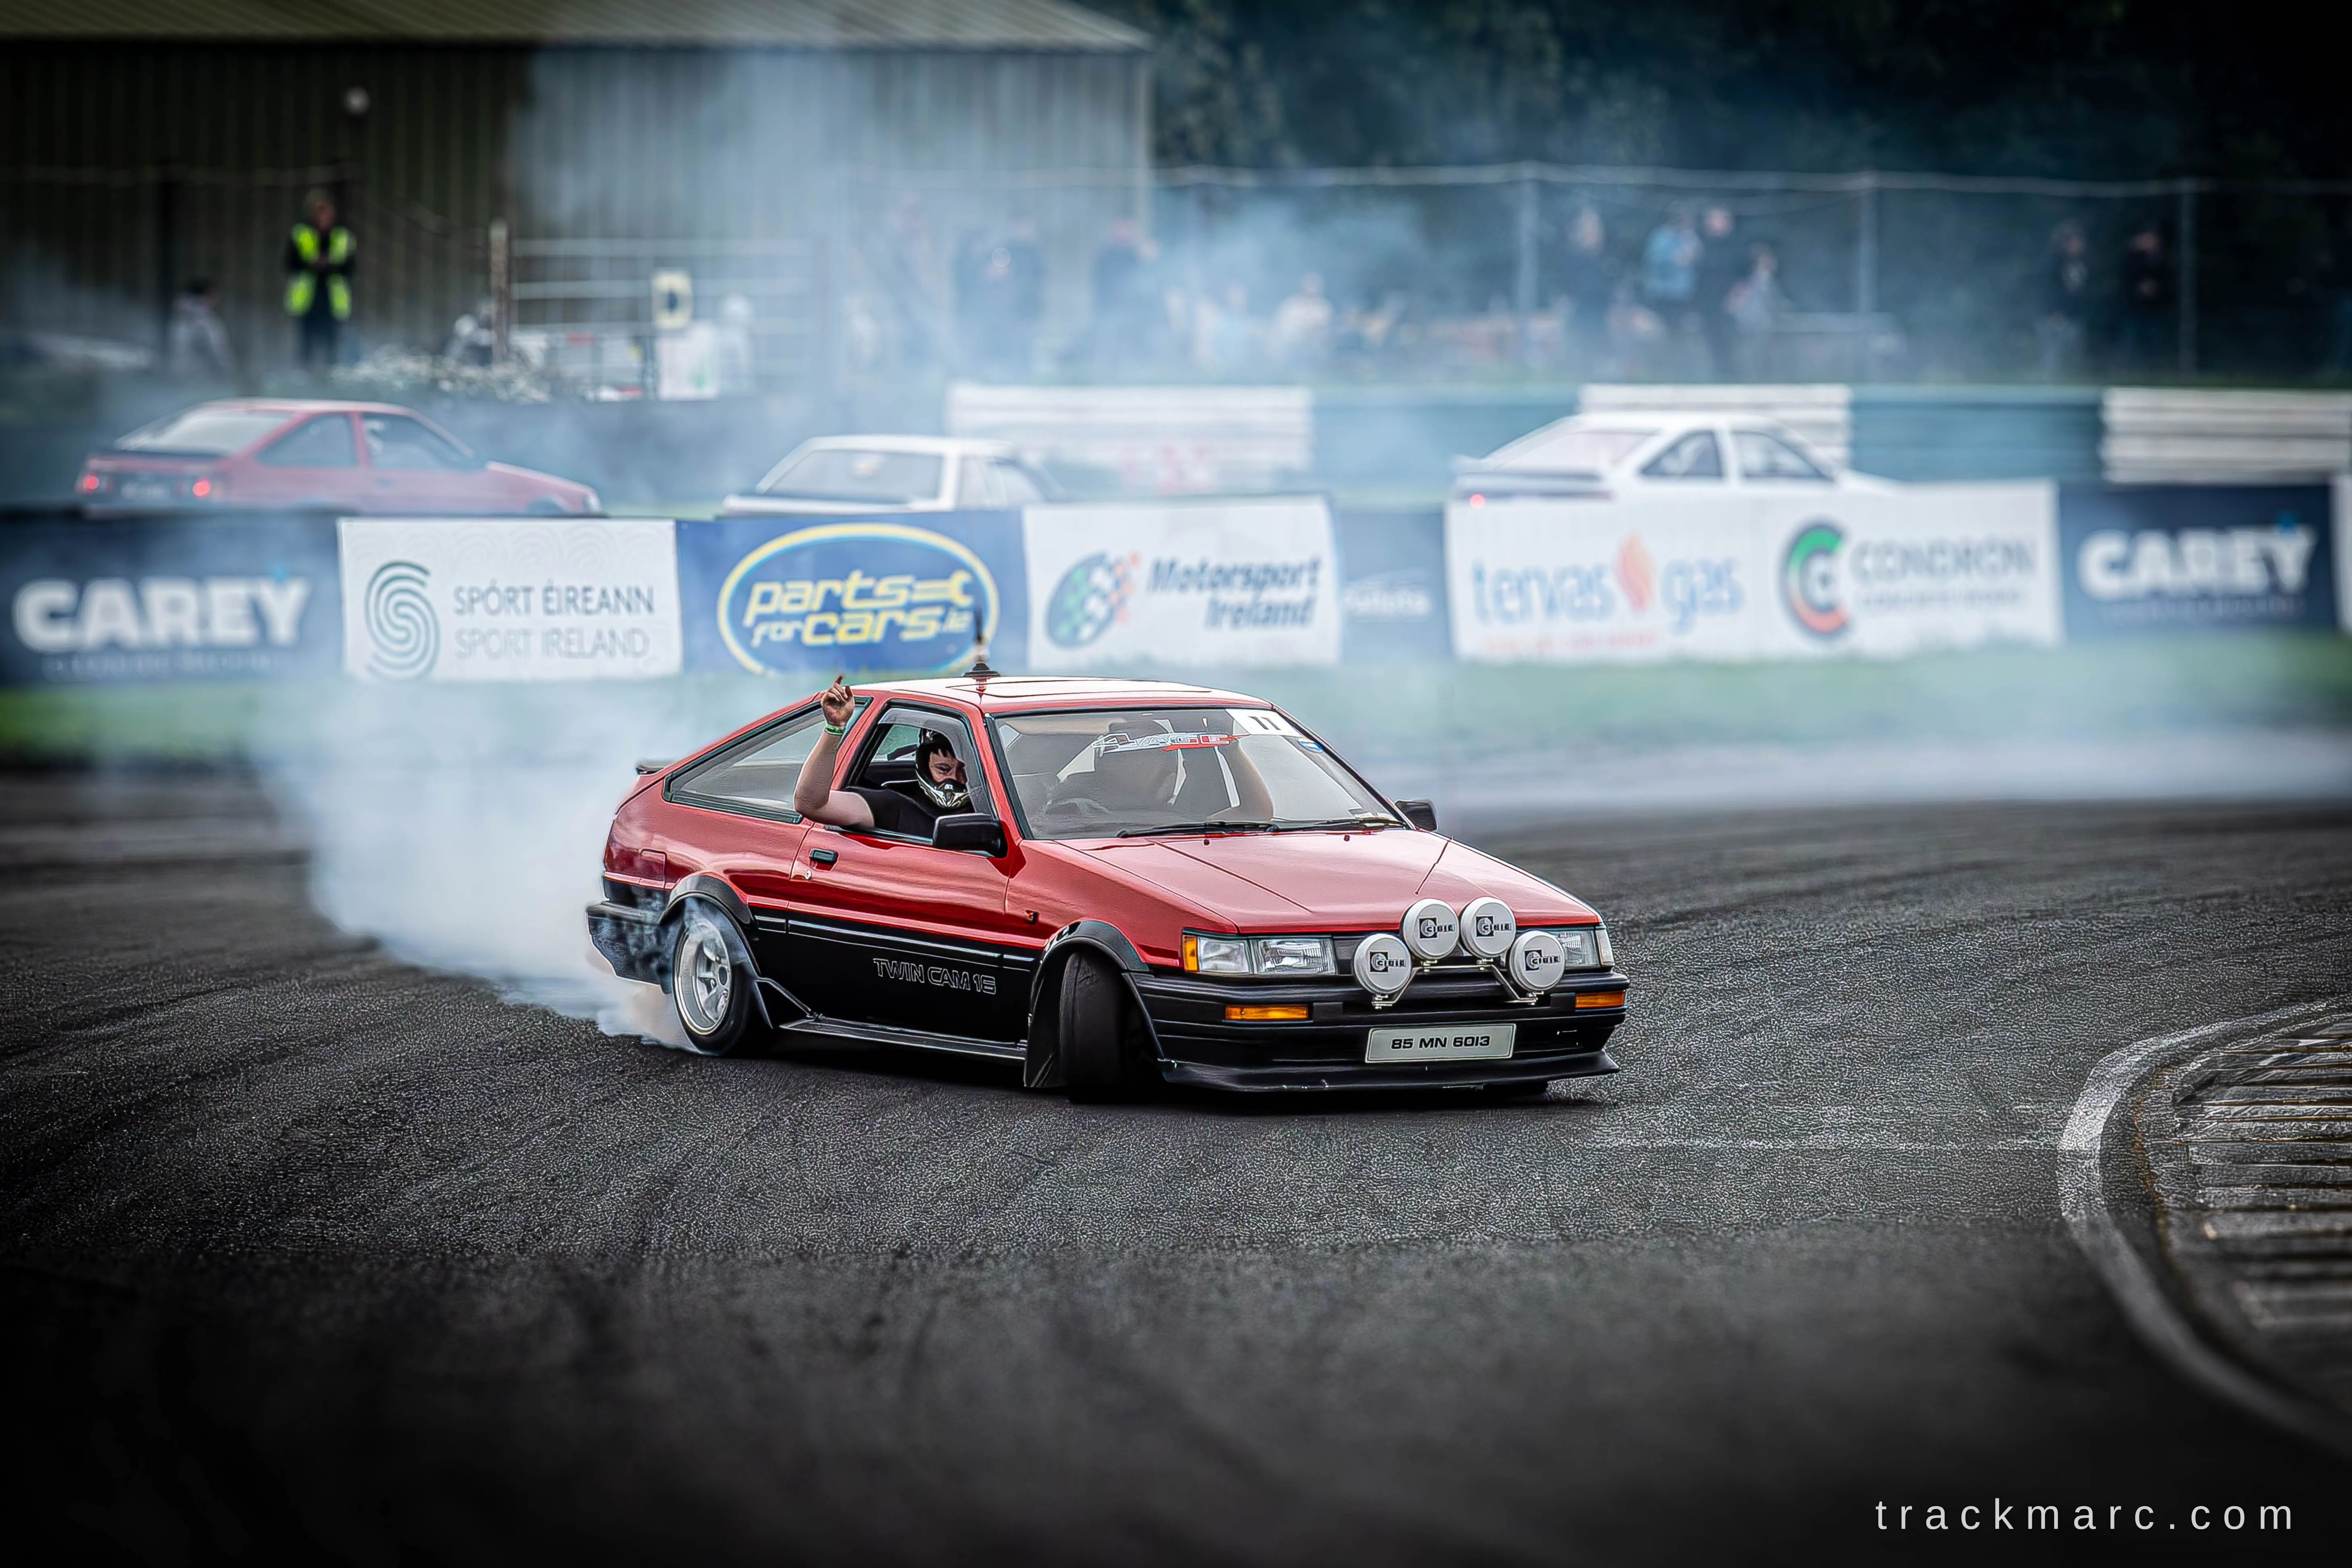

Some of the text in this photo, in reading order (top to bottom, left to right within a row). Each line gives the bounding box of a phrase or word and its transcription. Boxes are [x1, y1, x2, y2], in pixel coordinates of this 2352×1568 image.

[1147, 559, 1321, 593] Motorsport
[2079, 528, 2317, 599] CAREY
[14, 578, 307, 651] CAREY
[453, 578, 654, 615] SPÓRT ÉIREANN
[743, 569, 914, 627] parts
[1205, 596, 1316, 629] Ireland
[1661, 560, 1744, 634] gas
[455, 628, 650, 660] SPORT IRELAND
[752, 620, 804, 648] for
[873, 958, 996, 995] TWIN CAM 16
[1391, 1036, 1491, 1049] 85 MN 6013
